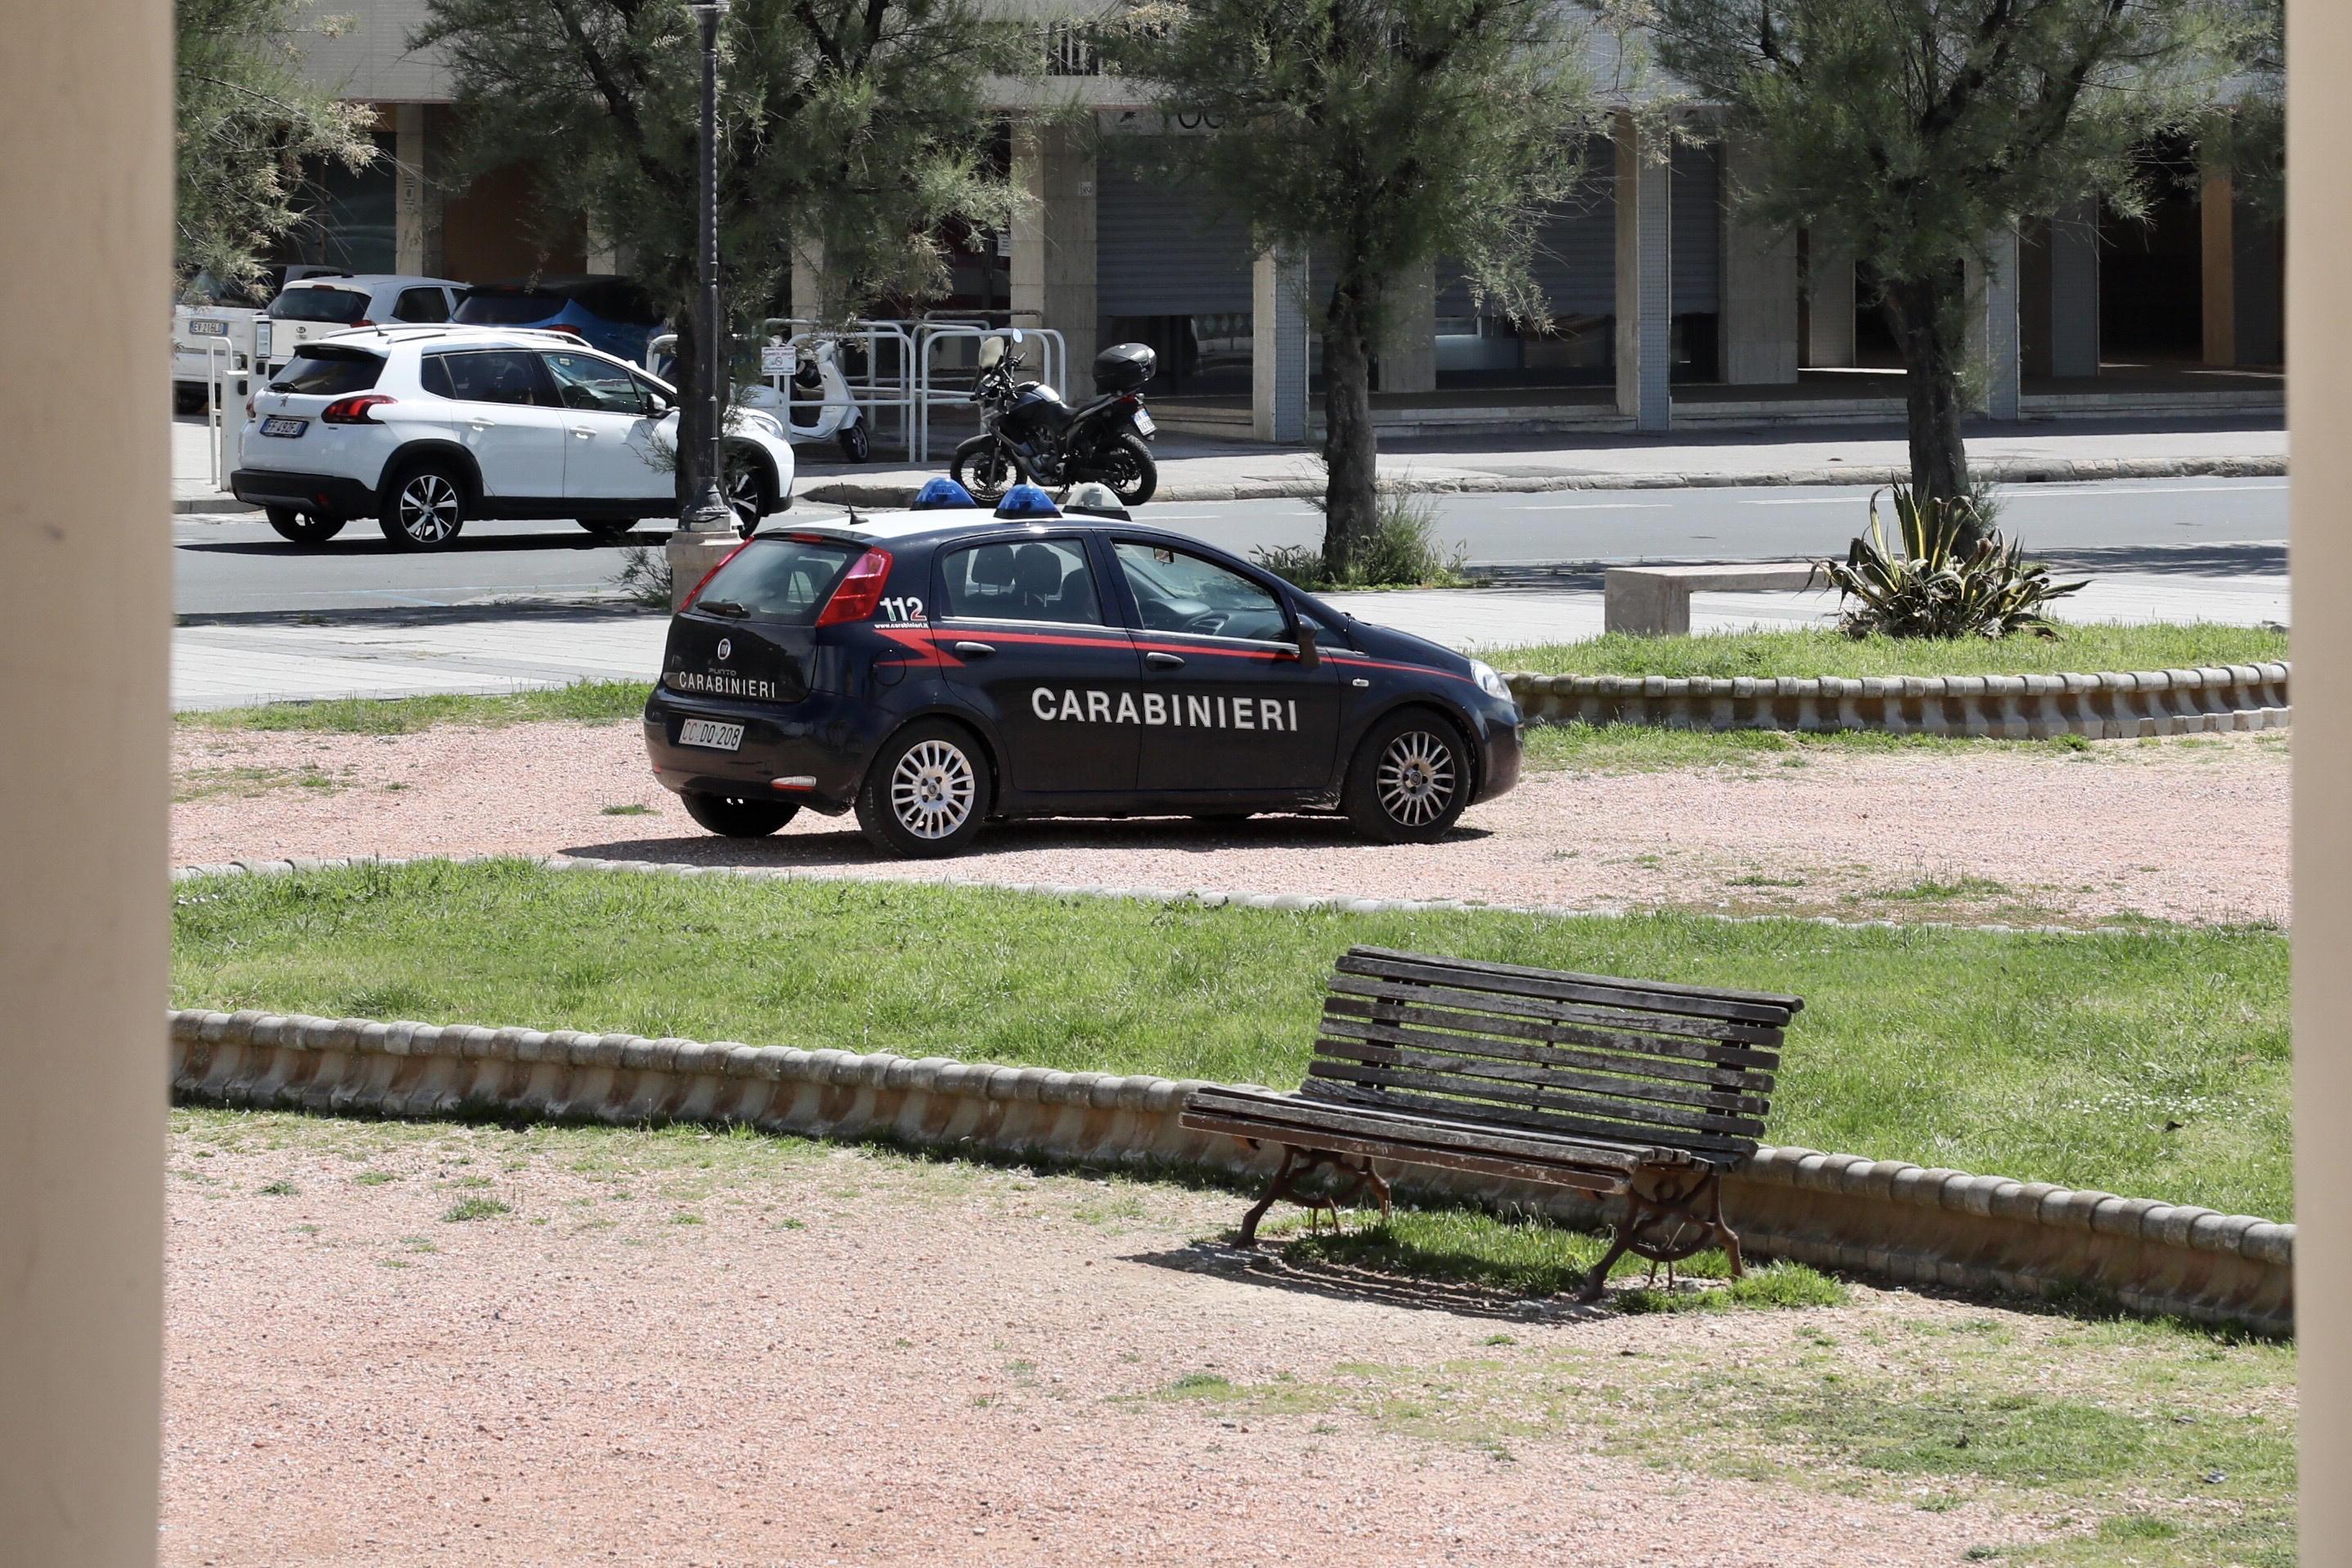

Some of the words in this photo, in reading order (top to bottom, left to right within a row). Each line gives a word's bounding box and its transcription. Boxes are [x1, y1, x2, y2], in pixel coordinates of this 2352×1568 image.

[879, 597, 927, 621] 112
[678, 671, 775, 699] CARABINIERI
[708, 668, 737, 676] PUNTO
[1031, 687, 1298, 732] CARABINIERI
[682, 721, 697, 741] CC
[716, 726, 741, 747] 208
